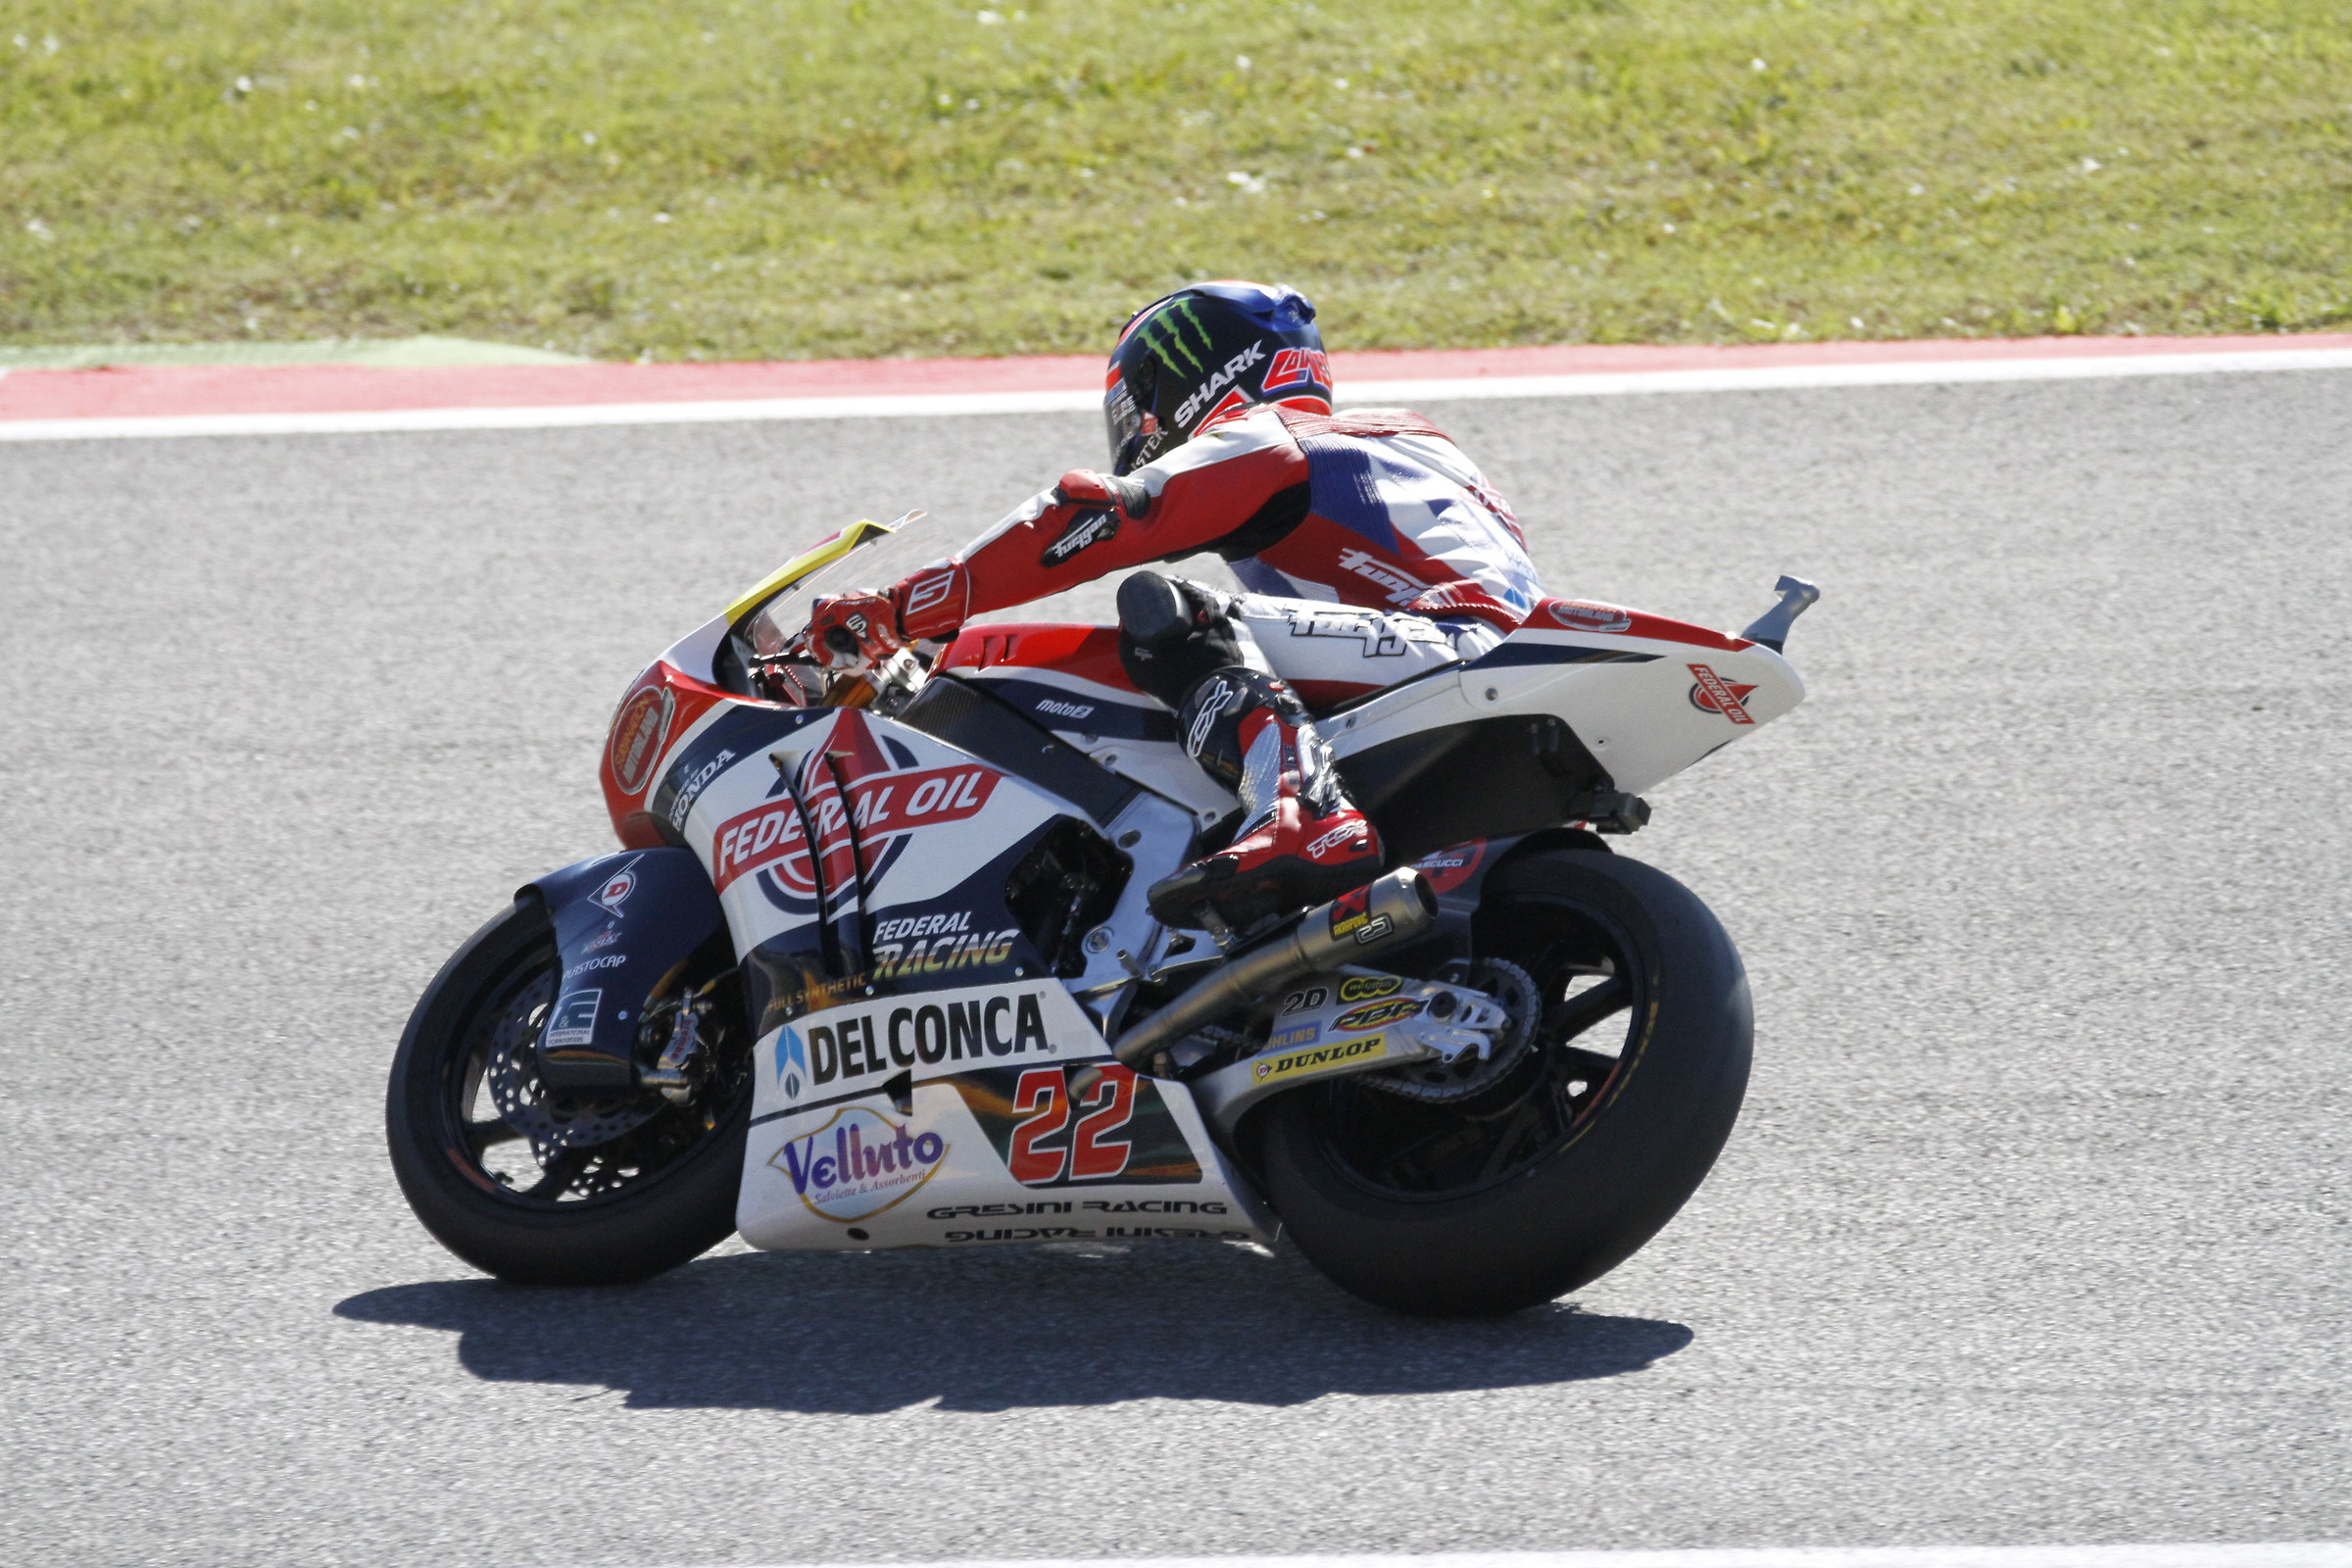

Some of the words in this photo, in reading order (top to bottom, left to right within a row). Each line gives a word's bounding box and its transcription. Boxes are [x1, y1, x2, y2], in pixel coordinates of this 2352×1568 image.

[1174, 340, 1266, 429] SHARK
[1693, 667, 1736, 707] FEDERAL
[1728, 709, 1748, 721] OIL
[672, 749, 736, 831] HONDA
[719, 786, 895, 877] FEDERAL
[906, 772, 983, 816] OIL
[873, 910, 972, 945] FEDERAL
[872, 929, 1021, 980] RACING
[1282, 988, 1328, 1017] 2D
[1275, 1038, 1381, 1073] DUNLOP
[1007, 1060, 1139, 1186] 22
[783, 1123, 944, 1196] Velluto
[814, 1186, 858, 1205] Salviette
[870, 1170, 925, 1192] Assorbenti
[926, 1201, 1073, 1220] GRESINI
[1082, 1200, 1228, 1215] RACING
